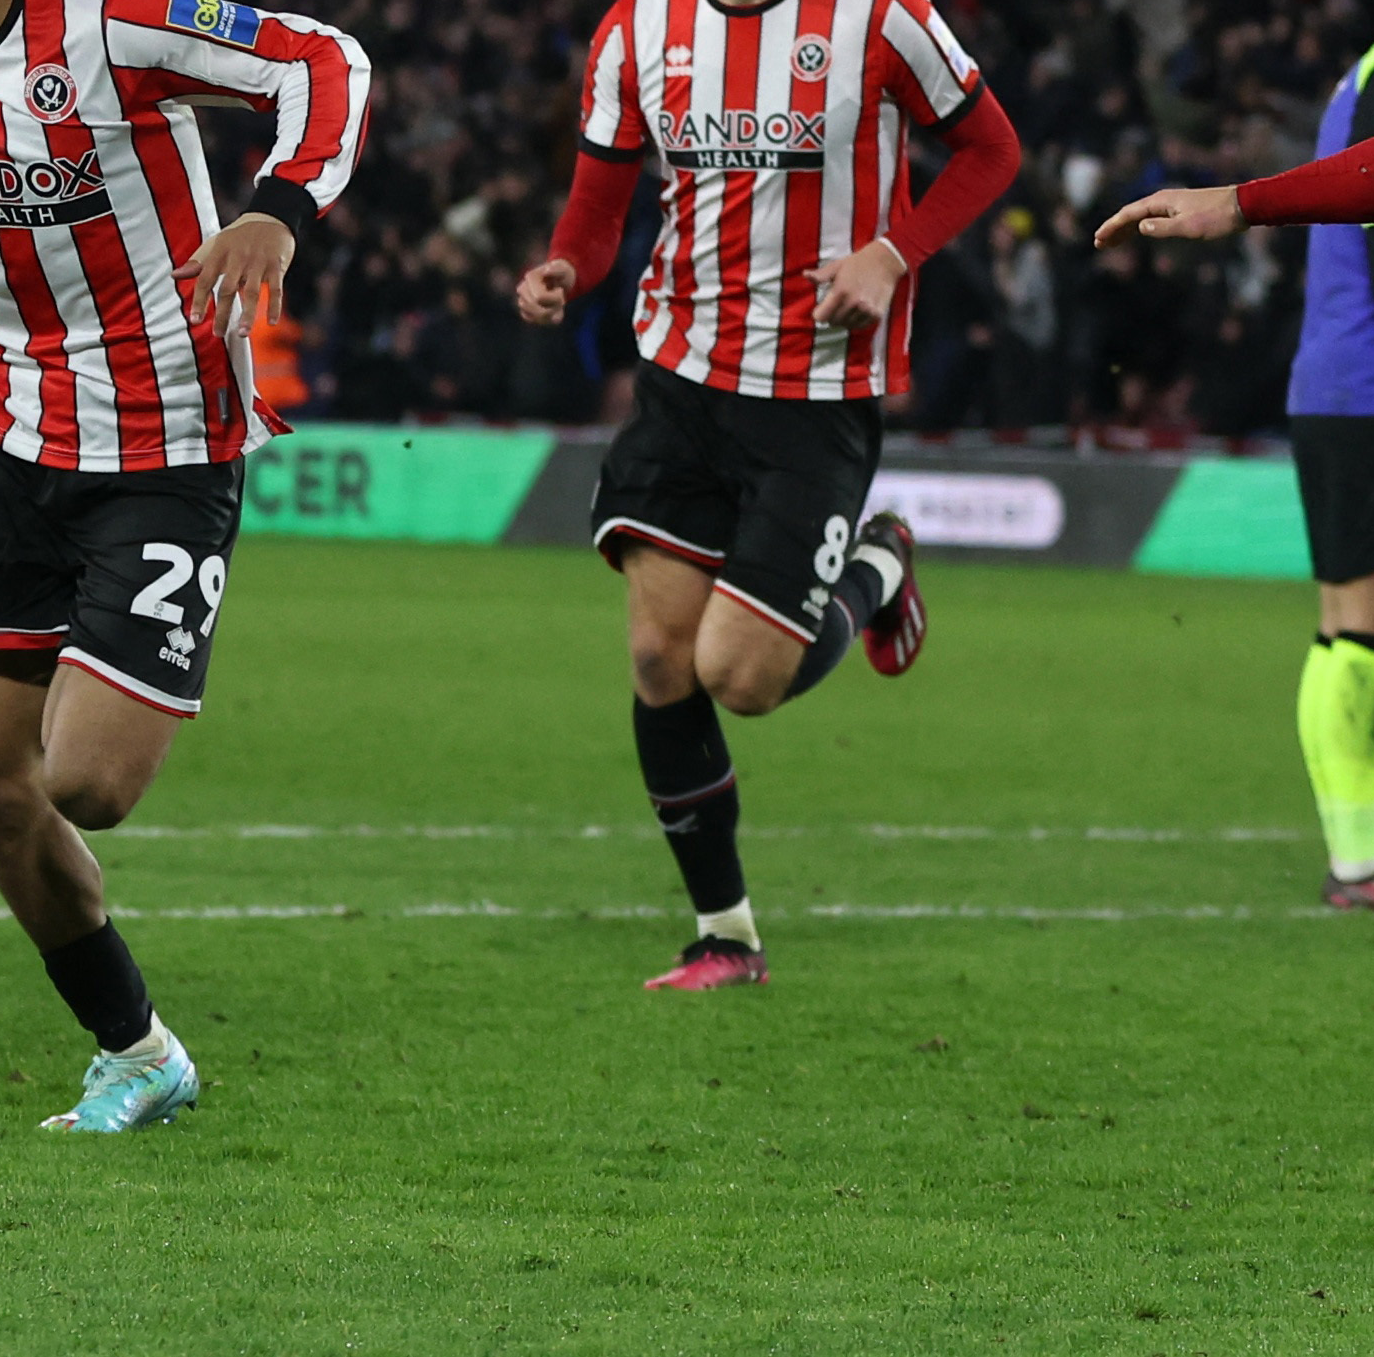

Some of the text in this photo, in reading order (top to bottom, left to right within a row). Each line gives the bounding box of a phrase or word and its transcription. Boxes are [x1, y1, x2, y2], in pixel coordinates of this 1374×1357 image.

[658, 111, 825, 148] RANDOX
[698, 152, 779, 168] HEALTH
[814, 514, 850, 585] 8
[130, 542, 226, 639] 29
[158, 646, 191, 672] errea
